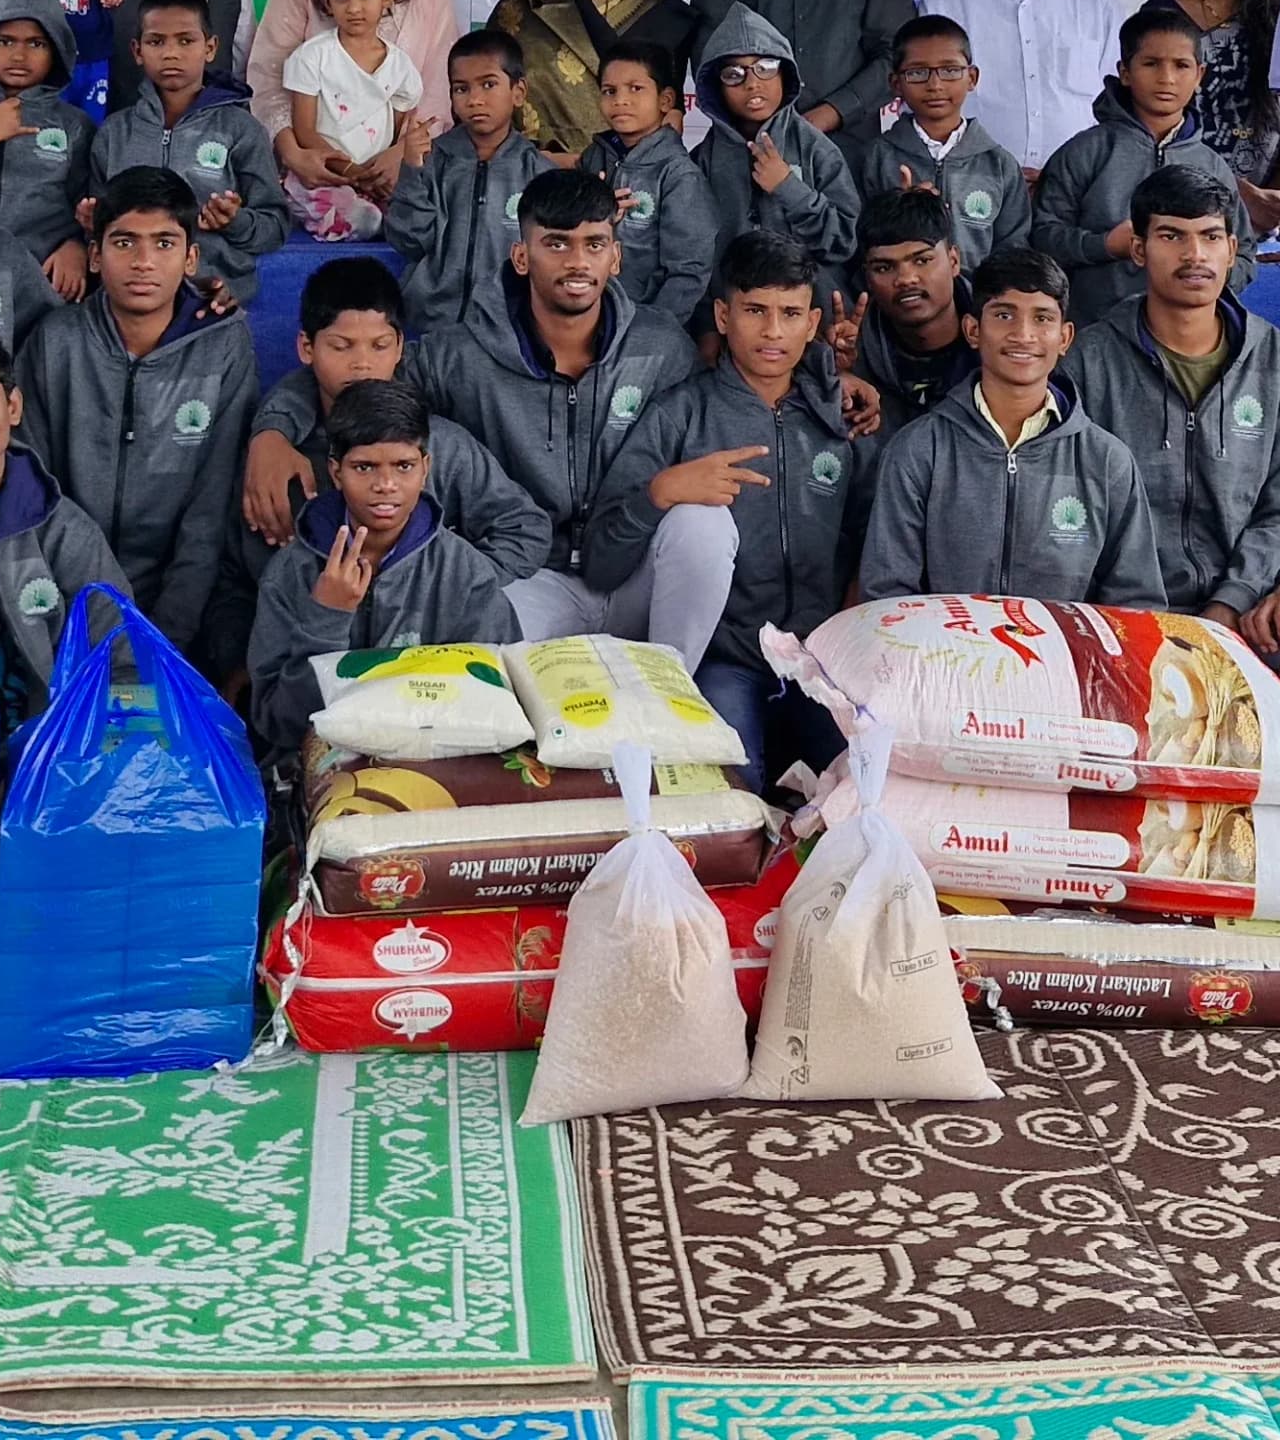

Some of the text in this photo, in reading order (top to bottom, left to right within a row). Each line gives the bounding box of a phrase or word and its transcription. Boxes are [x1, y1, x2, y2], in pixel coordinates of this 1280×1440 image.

[408, 680, 447, 690] SUGAR
[425, 690, 438, 701] kg
[961, 711, 1026, 740] Amul
[1057, 762, 1126, 790] Amul
[942, 824, 1009, 854] Amul
[448, 860, 485, 881] Rice
[488, 857, 542, 877] Kolam
[474, 879, 584, 898] 00% Sortex
[1044, 877, 1115, 901] Amul
[377, 943, 432, 957] SHUBHAM
[1006, 969, 1174, 998] Lachkari Kolam Rice
[393, 1005, 450, 1018] SHUBHAM
[1032, 999, 1147, 1019] 100% Sortex
